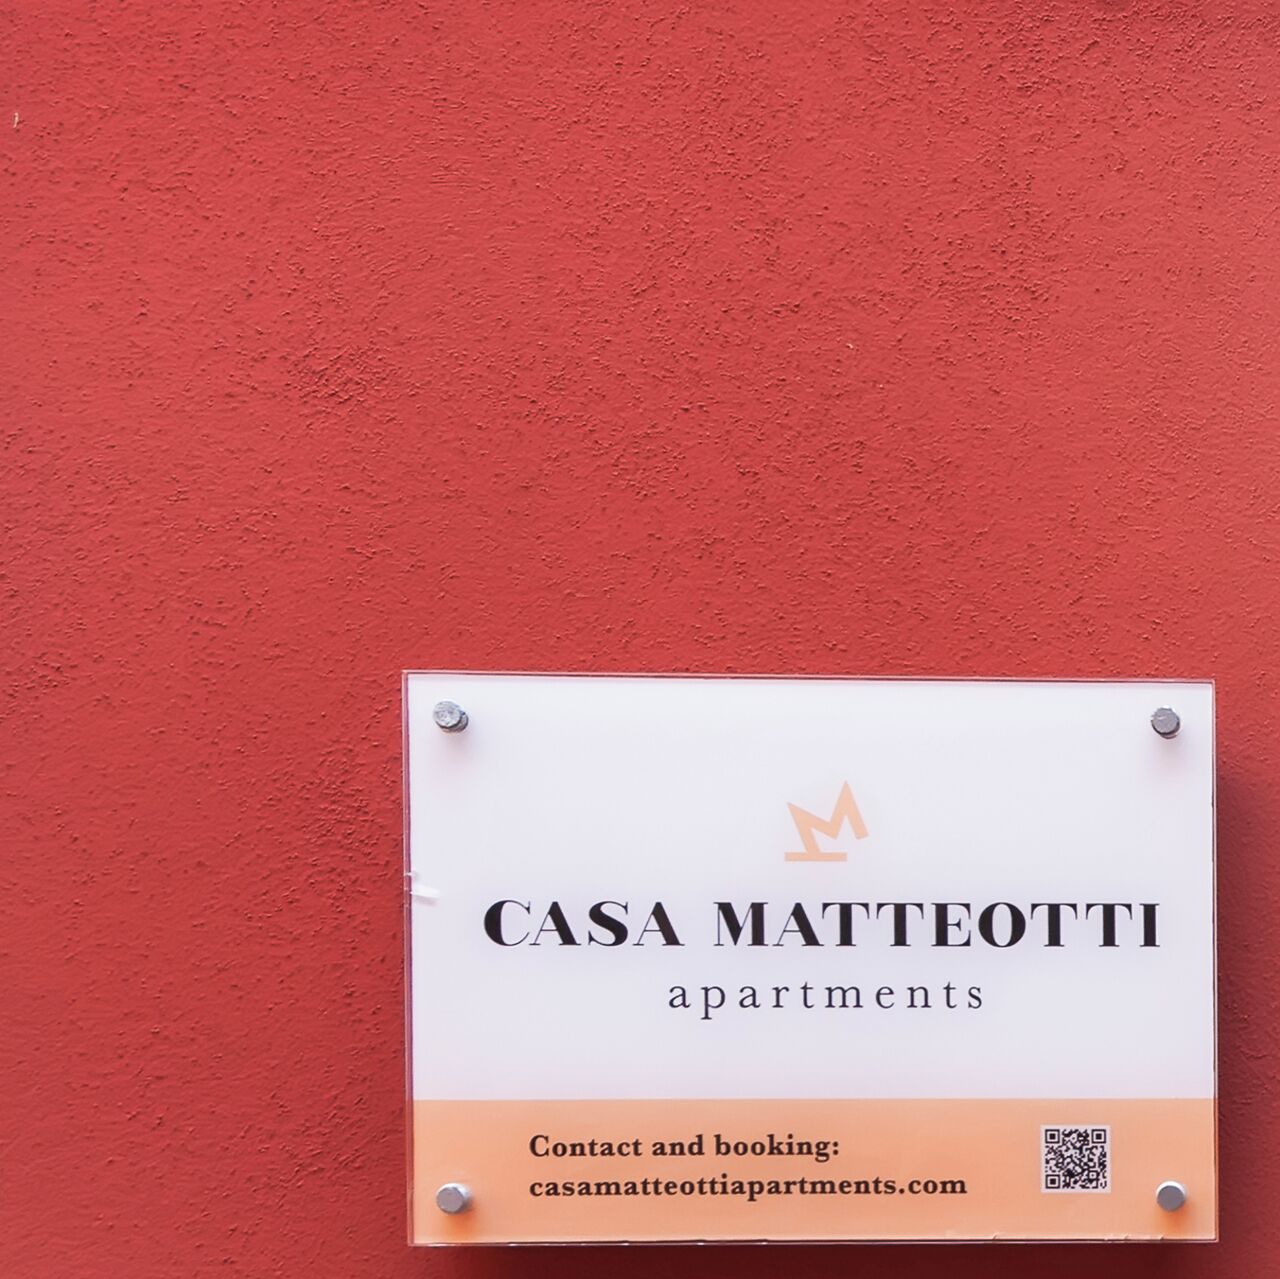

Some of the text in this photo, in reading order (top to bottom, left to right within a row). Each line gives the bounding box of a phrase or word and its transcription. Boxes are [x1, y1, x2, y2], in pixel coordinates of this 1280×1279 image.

[483, 899, 1161, 949] CASA MATTEOTTI
[668, 979, 984, 1020] apartments
[529, 1133, 840, 1163] Contact and booking:
[529, 1173, 968, 1202] casamatteottiapartments.com
